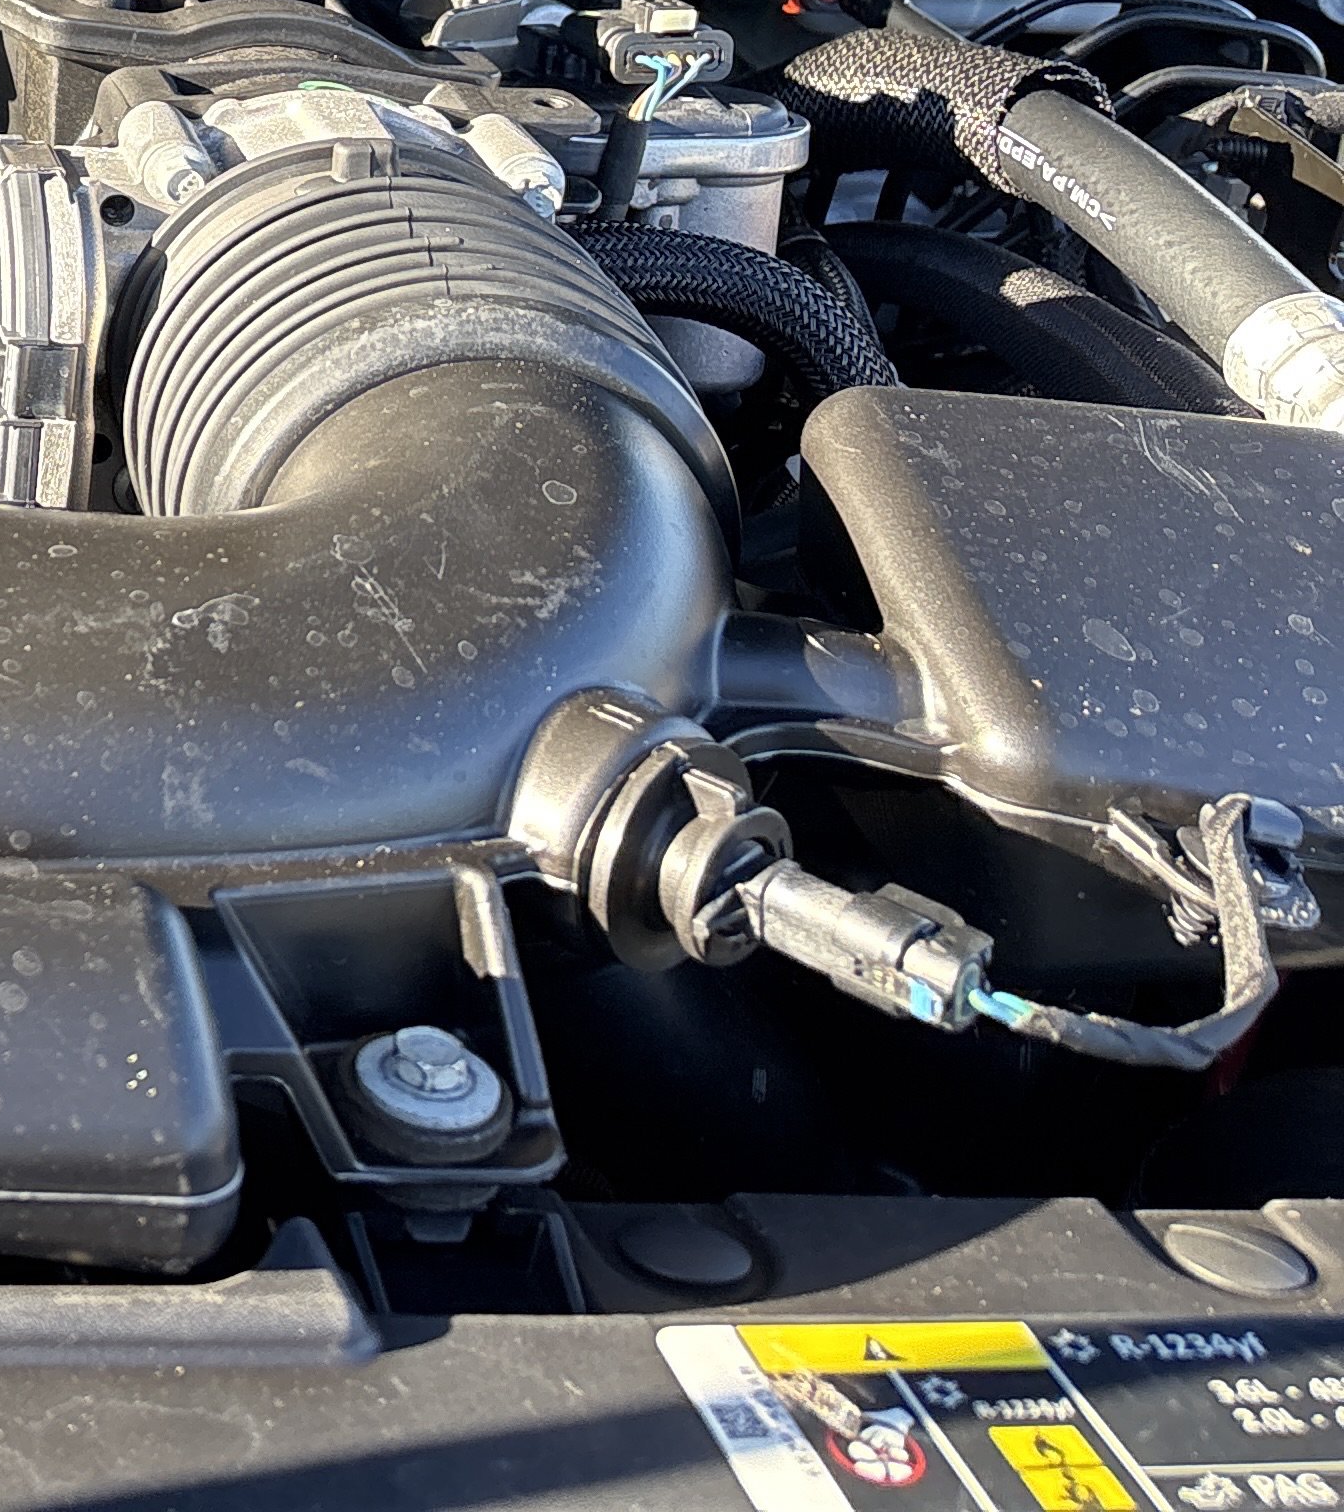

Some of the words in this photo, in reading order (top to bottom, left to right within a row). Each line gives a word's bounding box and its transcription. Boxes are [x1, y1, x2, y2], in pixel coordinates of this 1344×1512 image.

[996, 132, 1117, 231] >CM,PA,EPD
[1109, 1330, 1268, 1365] R-1234yf
[1247, 1472, 1340, 1509] PAG
